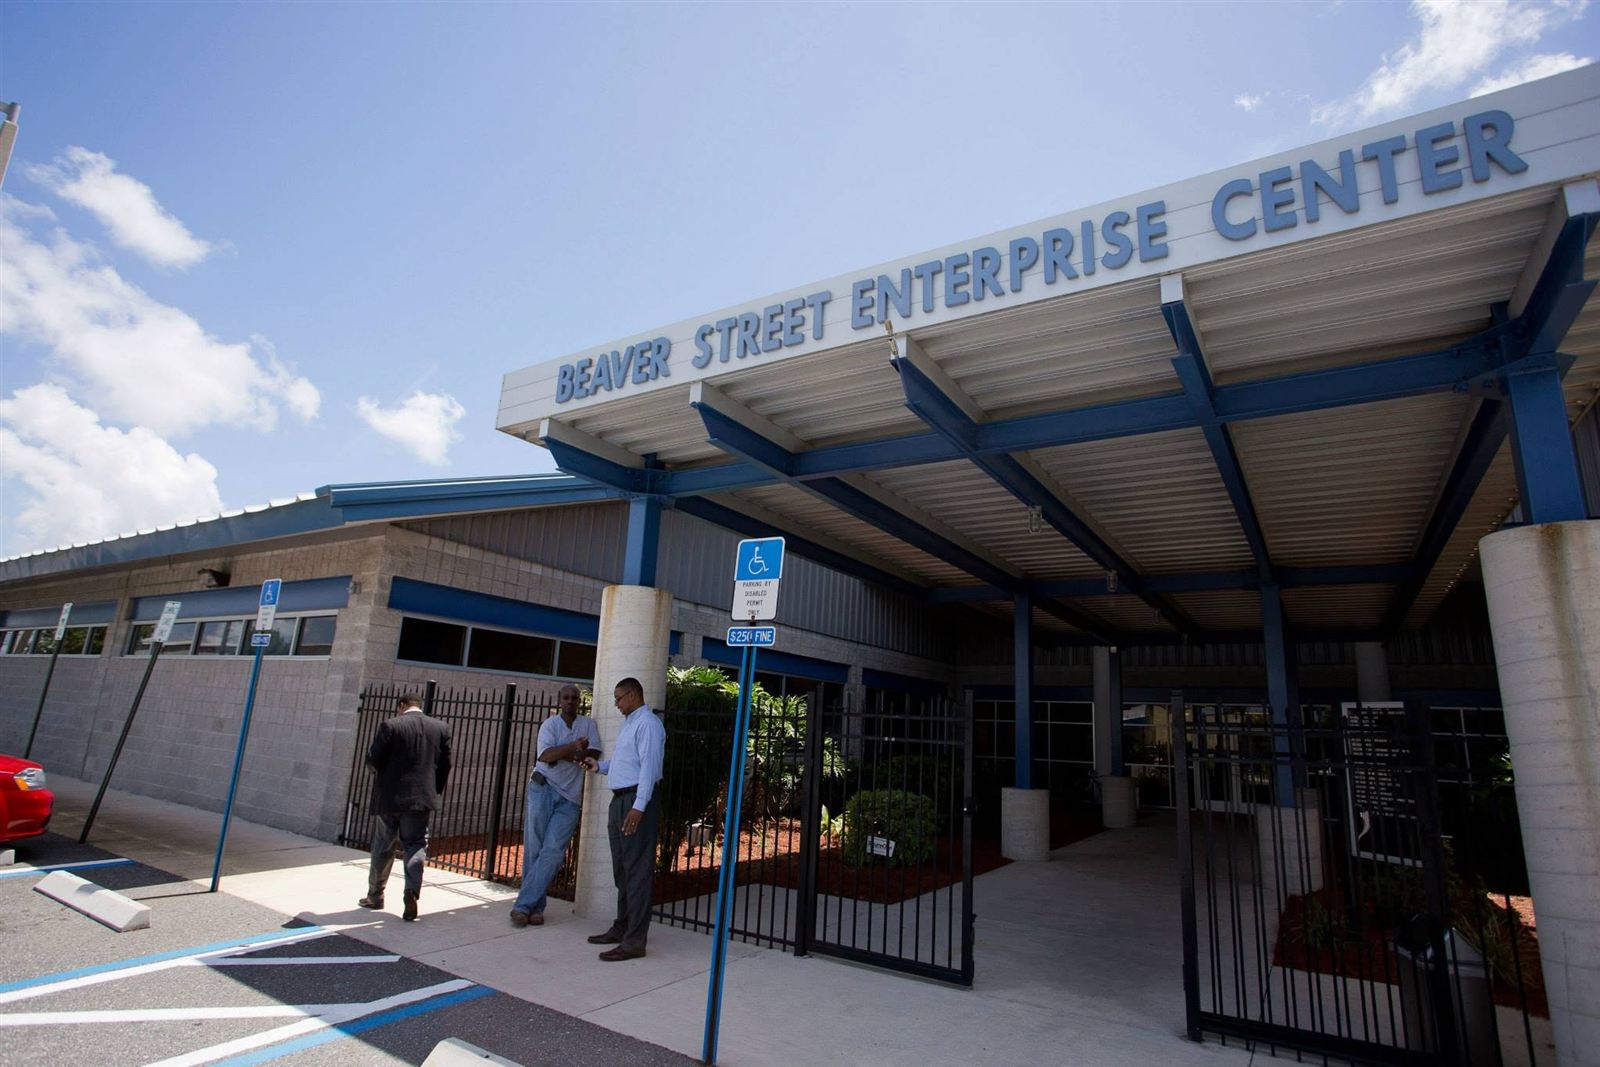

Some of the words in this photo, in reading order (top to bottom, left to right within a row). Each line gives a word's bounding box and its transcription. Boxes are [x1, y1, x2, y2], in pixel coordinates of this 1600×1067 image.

[555, 337, 671, 404] BEAVER
[691, 290, 831, 370] STREET
[851, 200, 1169, 330] ENTERPRISE
[1211, 109, 1529, 241] CENTER
[730, 630, 752, 643] $250
[754, 630, 773, 642] FINE
